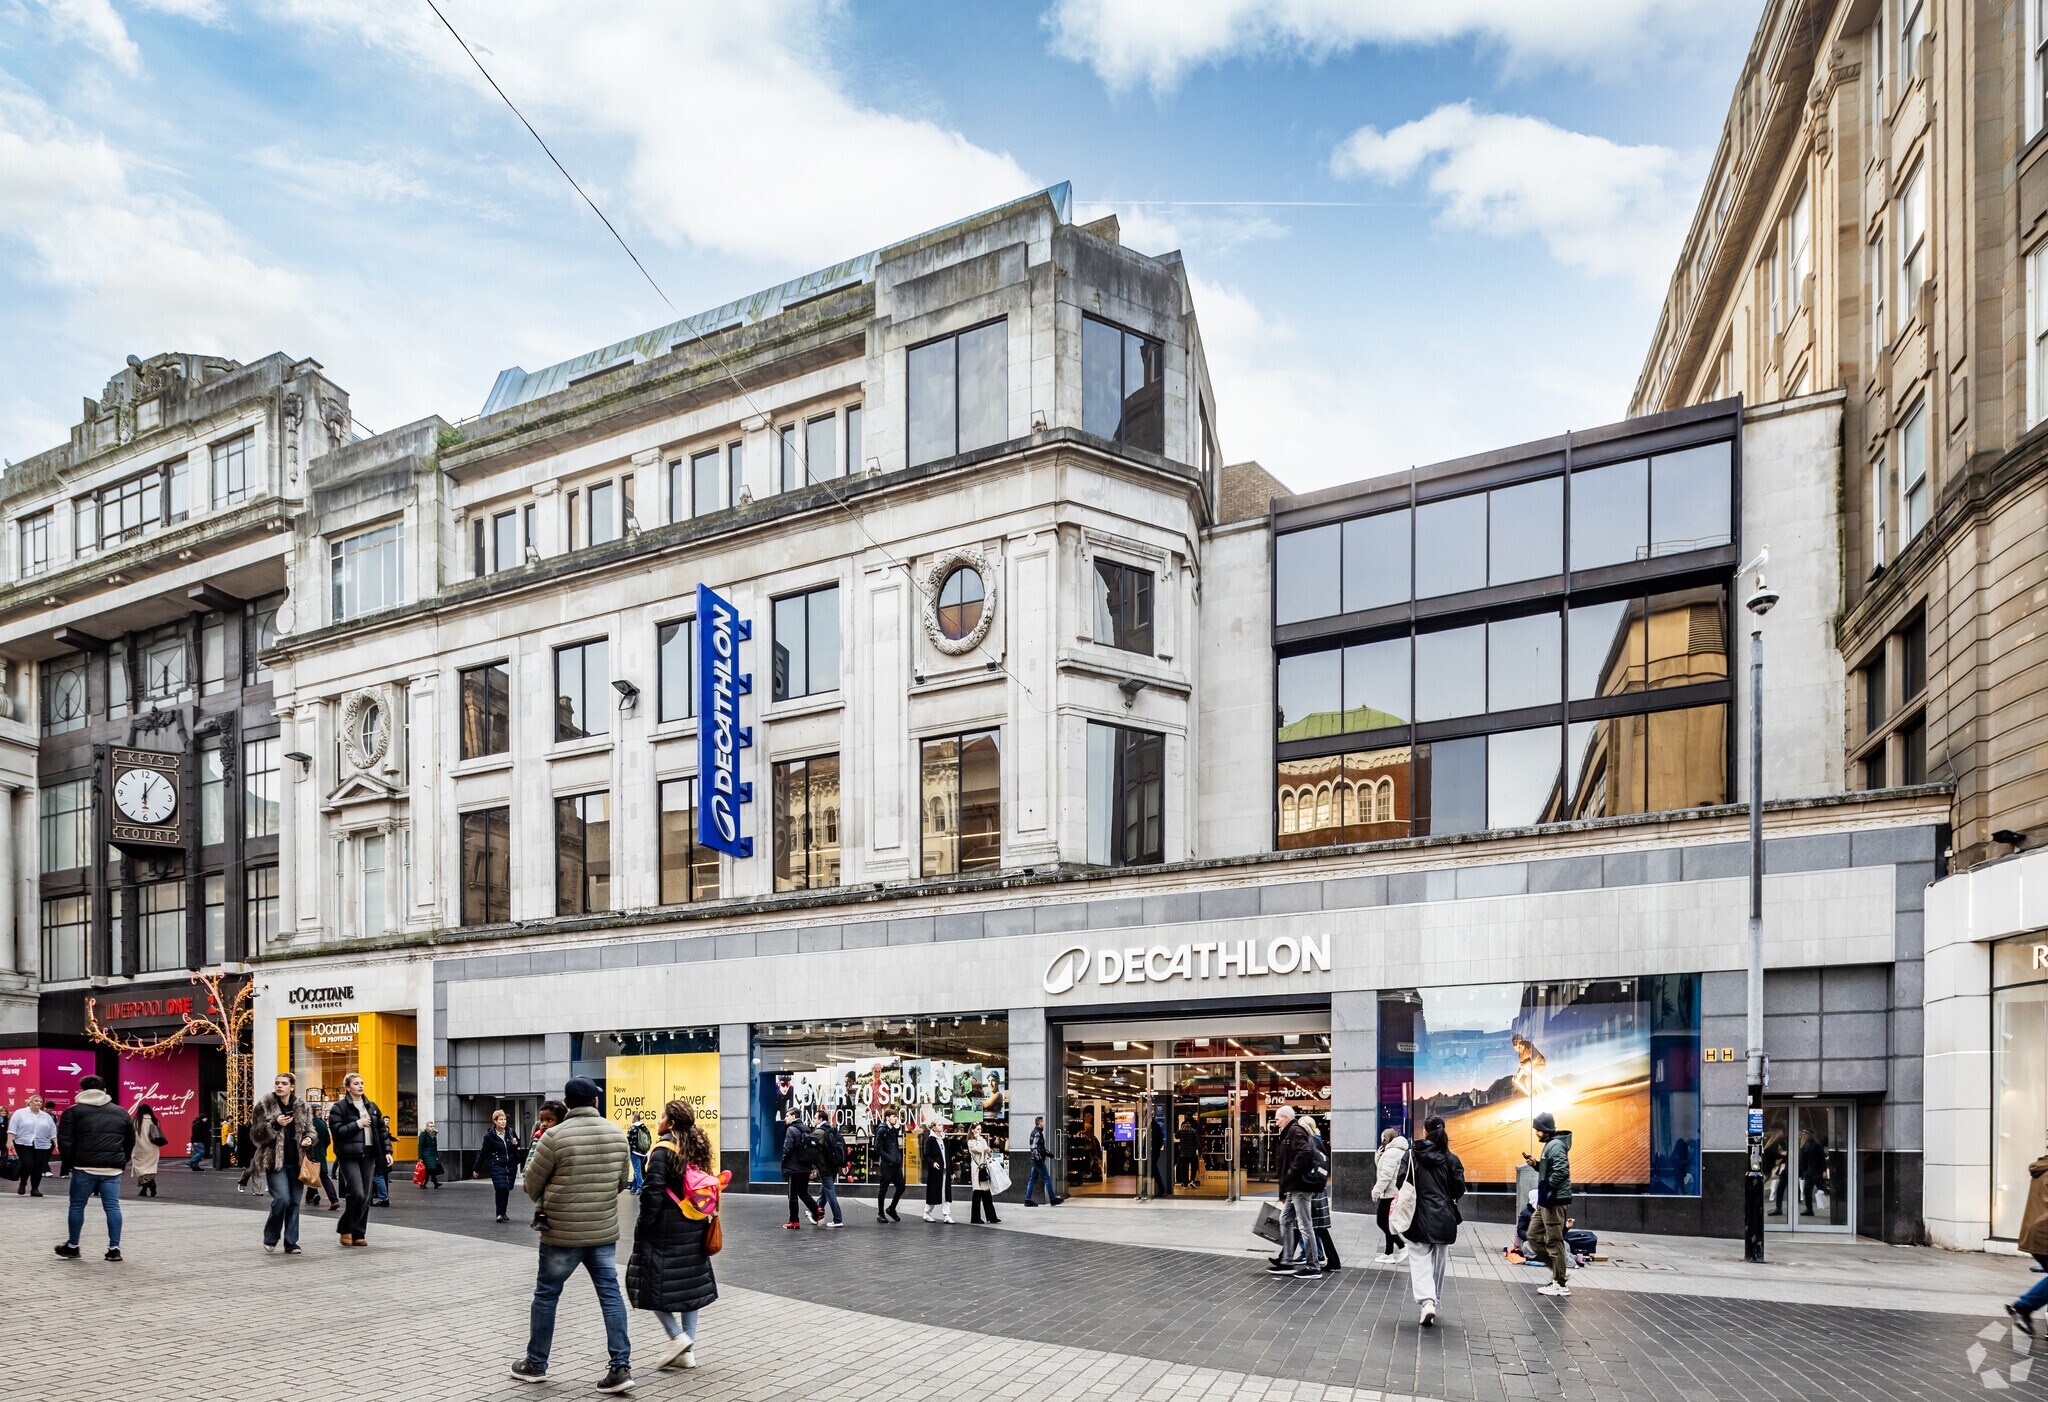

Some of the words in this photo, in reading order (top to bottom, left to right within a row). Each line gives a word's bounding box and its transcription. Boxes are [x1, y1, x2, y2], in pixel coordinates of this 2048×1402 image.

[713, 604, 732, 795] DECATHLON
[128, 752, 164, 766] KEYS
[168, 794, 172, 802] 3
[122, 828, 171, 841] COURT
[1099, 934, 1331, 984] DECATHLON
[289, 986, 354, 1004] L'OCCITANE
[106, 1000, 166, 1020] LIVERPOOL
[166, 997, 192, 1015] ONE
[7, 1058, 26, 1067] shopping
[128, 1082, 169, 1116] glow
[172, 1089, 194, 1108] up
[614, 1094, 645, 1106] Lower
[673, 1093, 706, 1106] Lower
[802, 1083, 847, 1106] OVER
[852, 1084, 873, 1106] 70
[878, 1082, 952, 1105] SPORTS
[694, 1106, 718, 1120] ices
[867, 1108, 884, 1125] AN
